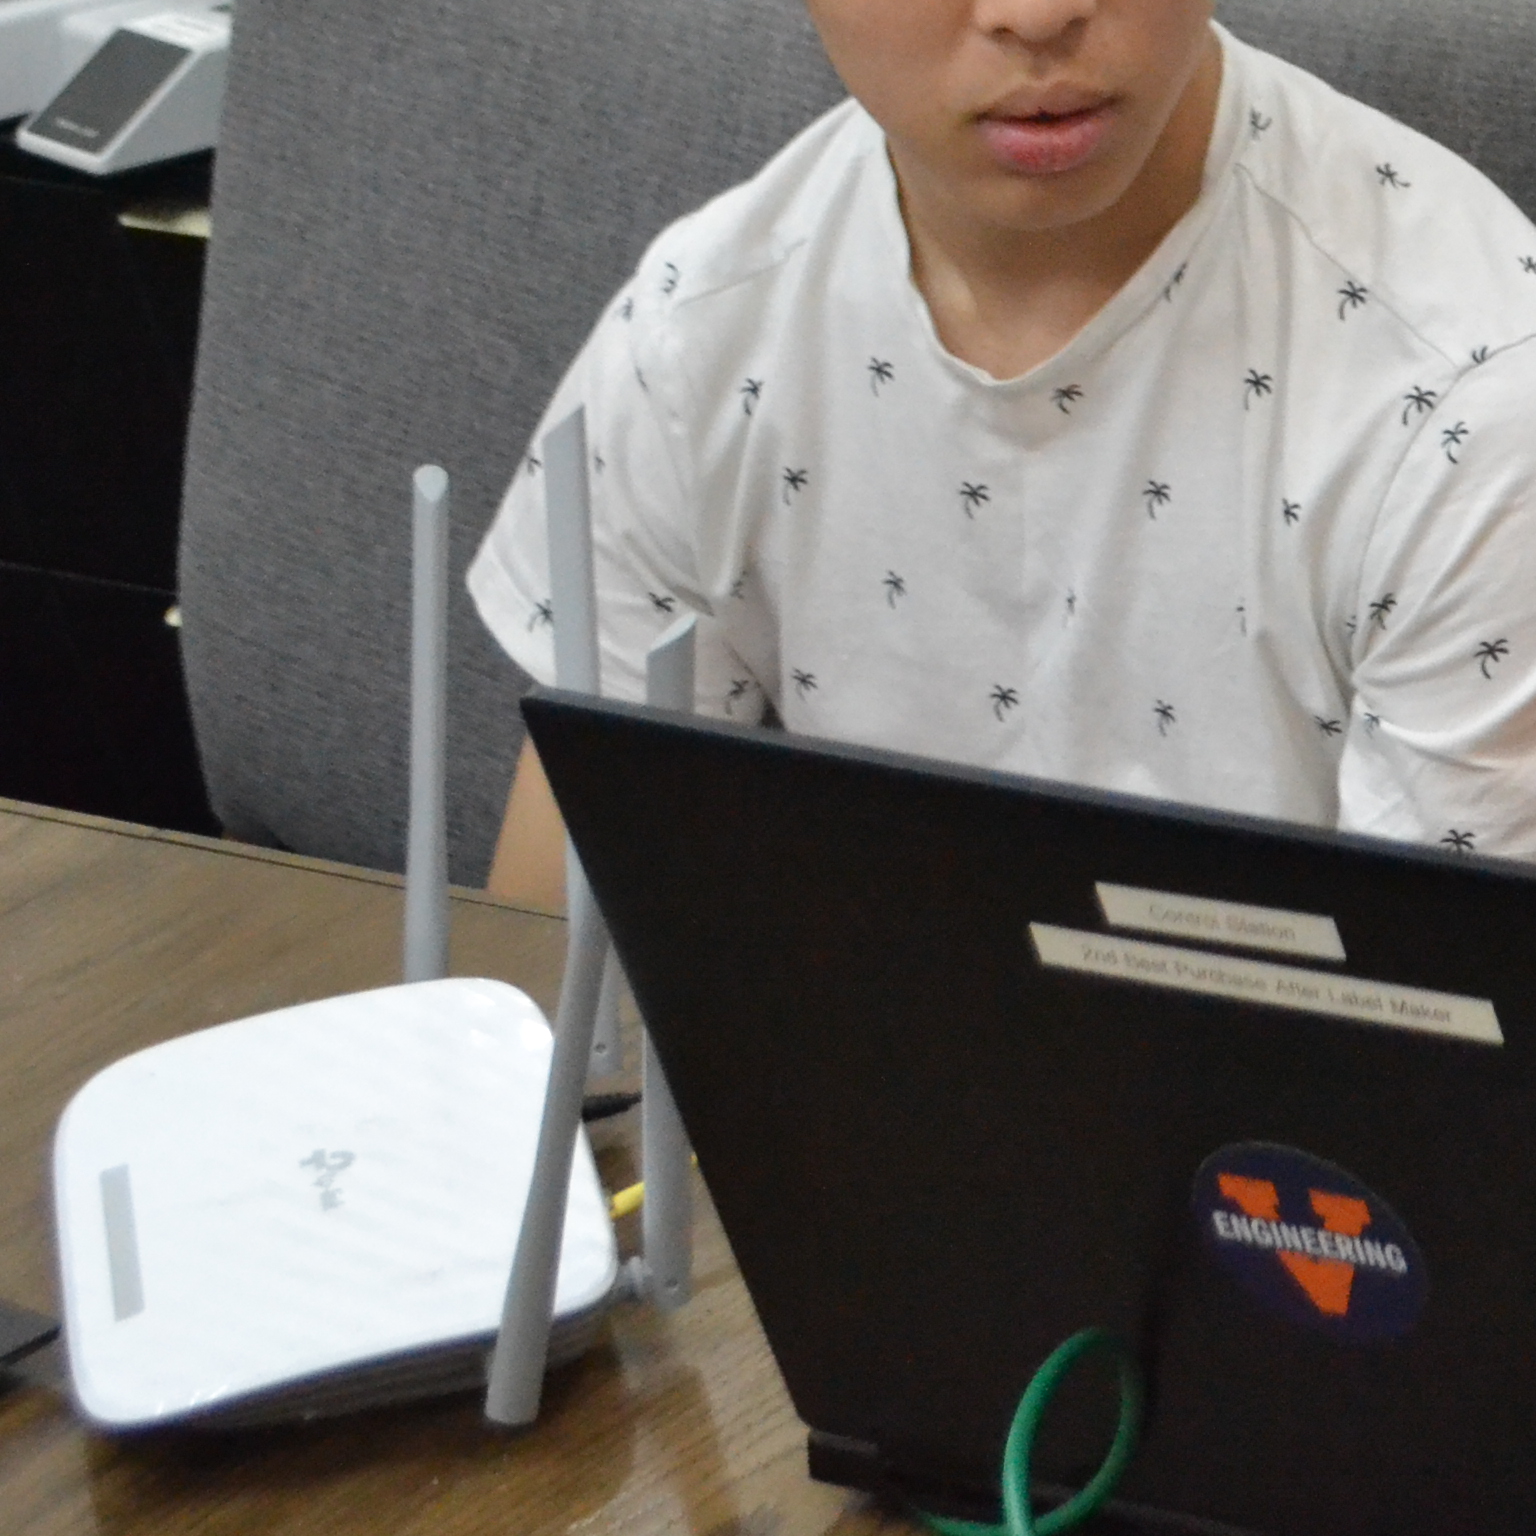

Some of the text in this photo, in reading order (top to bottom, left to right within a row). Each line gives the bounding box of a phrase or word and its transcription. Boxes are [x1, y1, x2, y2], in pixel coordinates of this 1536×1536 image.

[1173, 959, 1268, 992] Purchase
[1275, 977, 1320, 1000] After
[1327, 987, 1384, 1012] Label
[1388, 996, 1451, 1024] Maker
[1210, 1209, 1409, 1275] ENGINEERING
